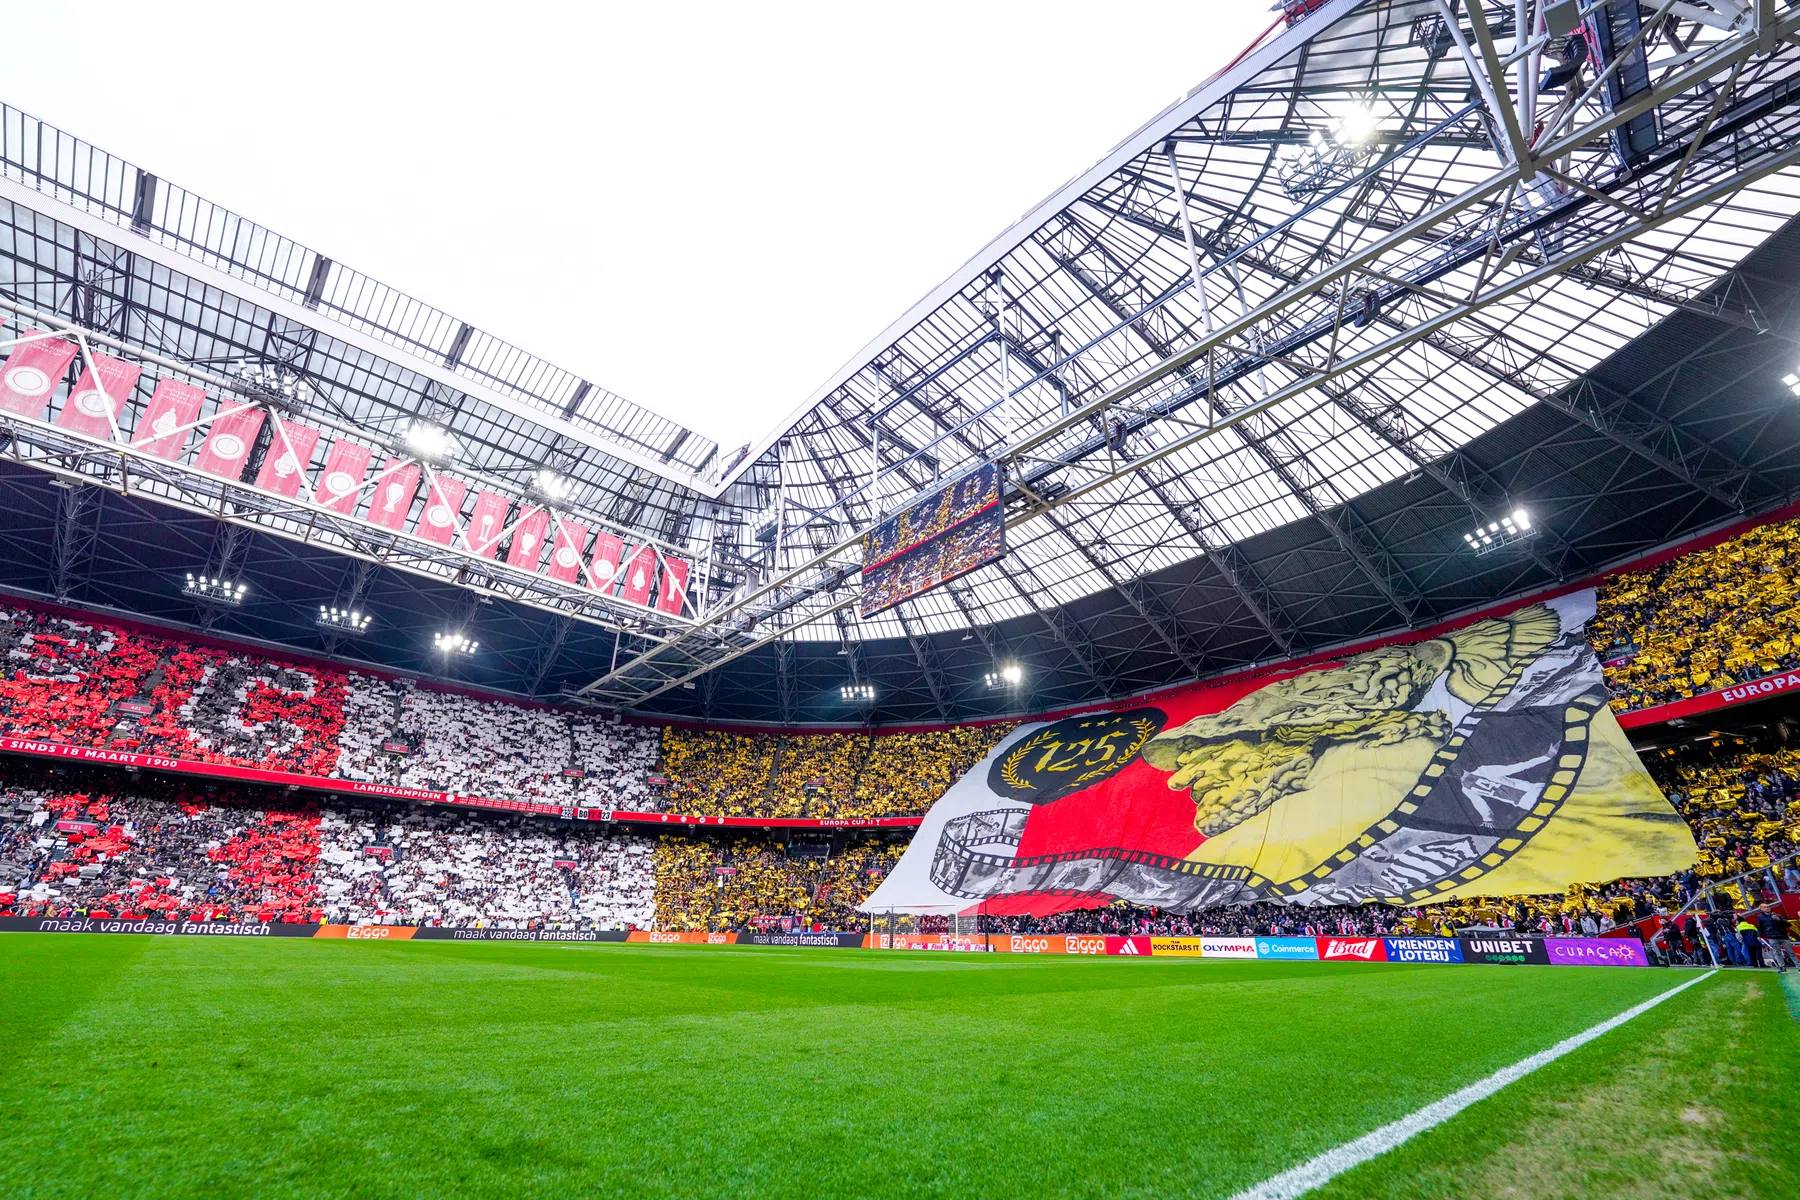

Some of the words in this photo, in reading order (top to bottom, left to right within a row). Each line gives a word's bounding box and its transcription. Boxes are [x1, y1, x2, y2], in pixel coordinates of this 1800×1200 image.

[1721, 674, 1800, 702] EUROPA
[10, 740, 57, 754] SINDS
[62, 747, 79, 756] 18
[84, 749, 138, 763] MAART
[146, 757, 178, 768] 1900
[1034, 730, 1129, 773] 125
[353, 783, 442, 800] LANDSKAMPIOEN
[39, 919, 95, 932] maak
[100, 919, 176, 936] vandaag
[180, 920, 271, 935] fantastisch
[454, 930, 487, 940] maak
[489, 930, 536, 942] vandaag
[538, 930, 597, 941] fantastisch
[753, 934, 770, 944] maak
[771, 934, 798, 946] vandaag
[799, 933, 839, 946] fantastisch
[1152, 943, 1192, 952] ROCKSTARS
[1192, 944, 1199, 952] IT
[1202, 944, 1255, 952] OLYMPIA
[1271, 944, 1315, 953] Coinmerce
[1388, 939, 1456, 951] VRIENDEN
[1470, 940, 1533, 953] UNIBET
[1400, 950, 1450, 962] LOTERIJ
